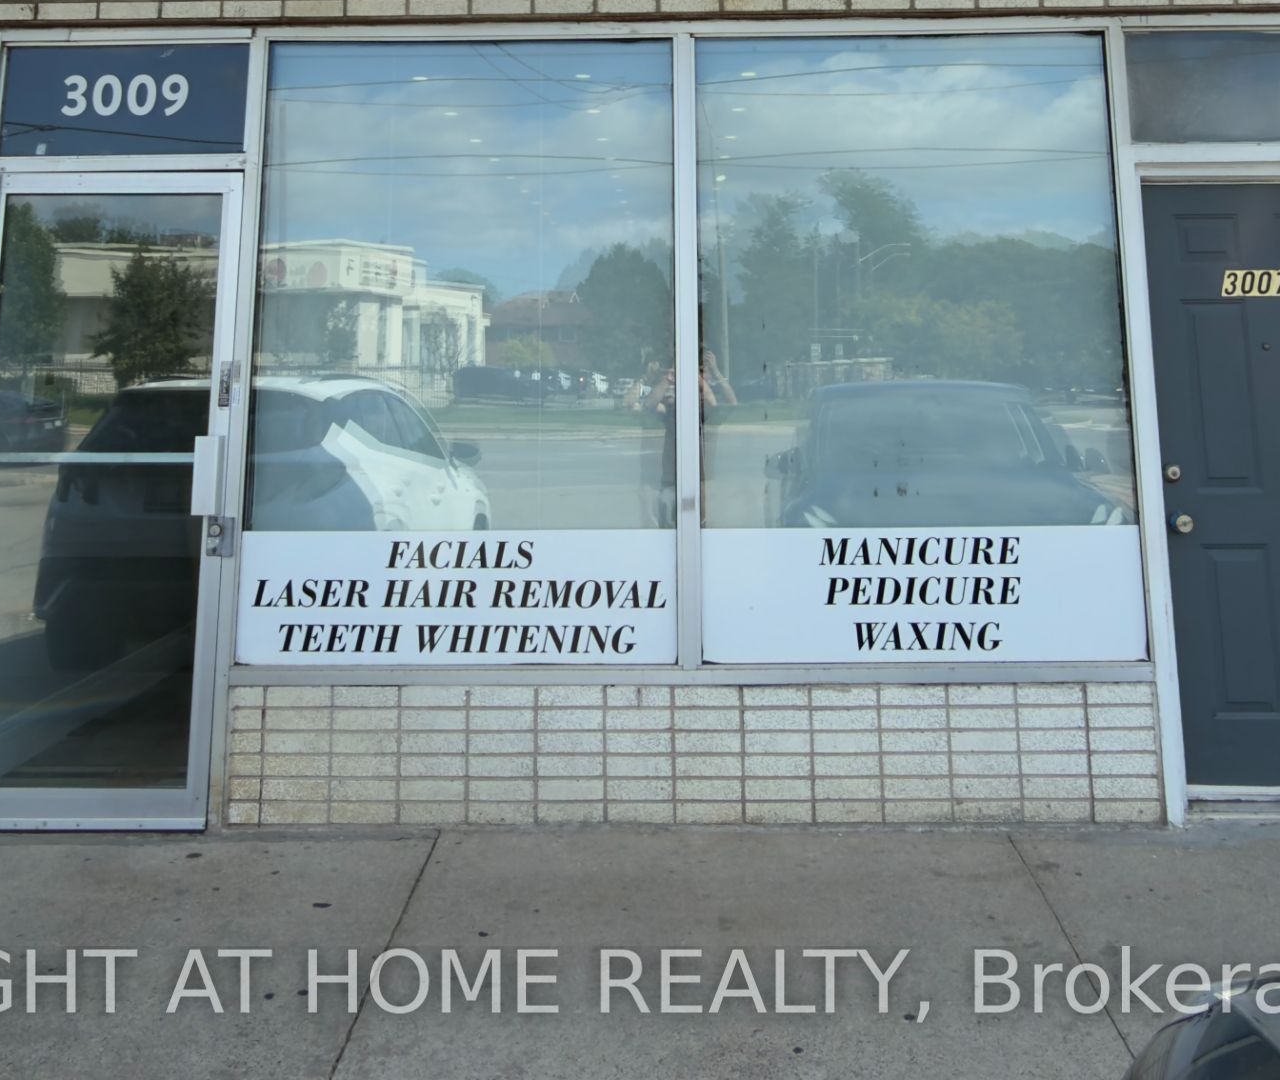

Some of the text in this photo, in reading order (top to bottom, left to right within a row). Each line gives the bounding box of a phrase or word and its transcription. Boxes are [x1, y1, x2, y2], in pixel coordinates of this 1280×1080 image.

[60, 73, 190, 117] 3009
[385, 540, 535, 570] FACIALS
[818, 536, 1021, 566] MANICURE
[251, 578, 668, 609] LASER HAIR REMOVAL
[824, 576, 1022, 605] PEDICURE
[278, 624, 637, 654] TEETH WHITENING
[853, 621, 1003, 651] WAXING
